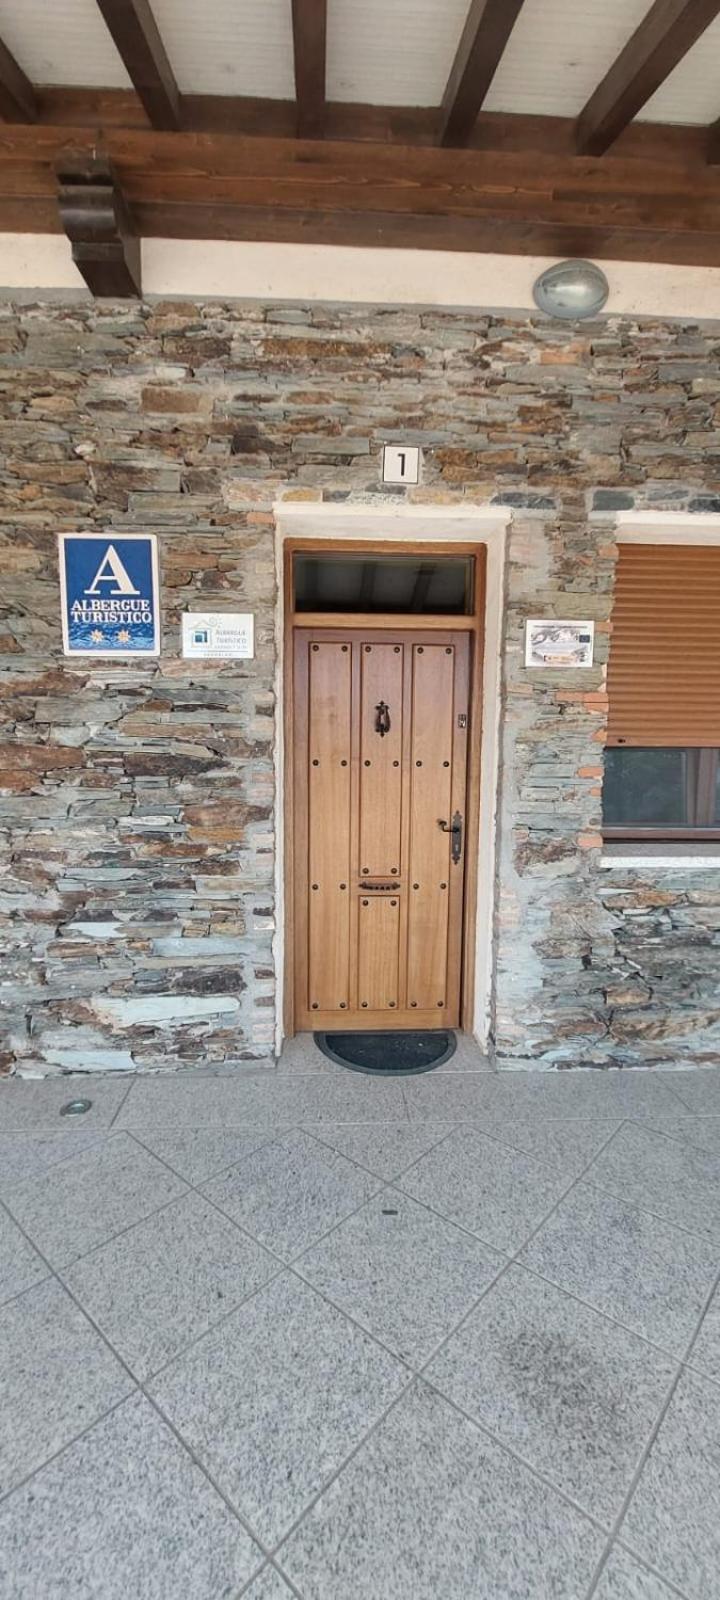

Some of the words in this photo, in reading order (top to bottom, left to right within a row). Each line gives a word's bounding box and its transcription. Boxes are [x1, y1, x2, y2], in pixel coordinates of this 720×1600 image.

[397, 452, 406, 477] 1
[84, 544, 140, 595] A
[71, 599, 150, 611] ALBERGUE
[70, 611, 152, 624] TURISTICO
